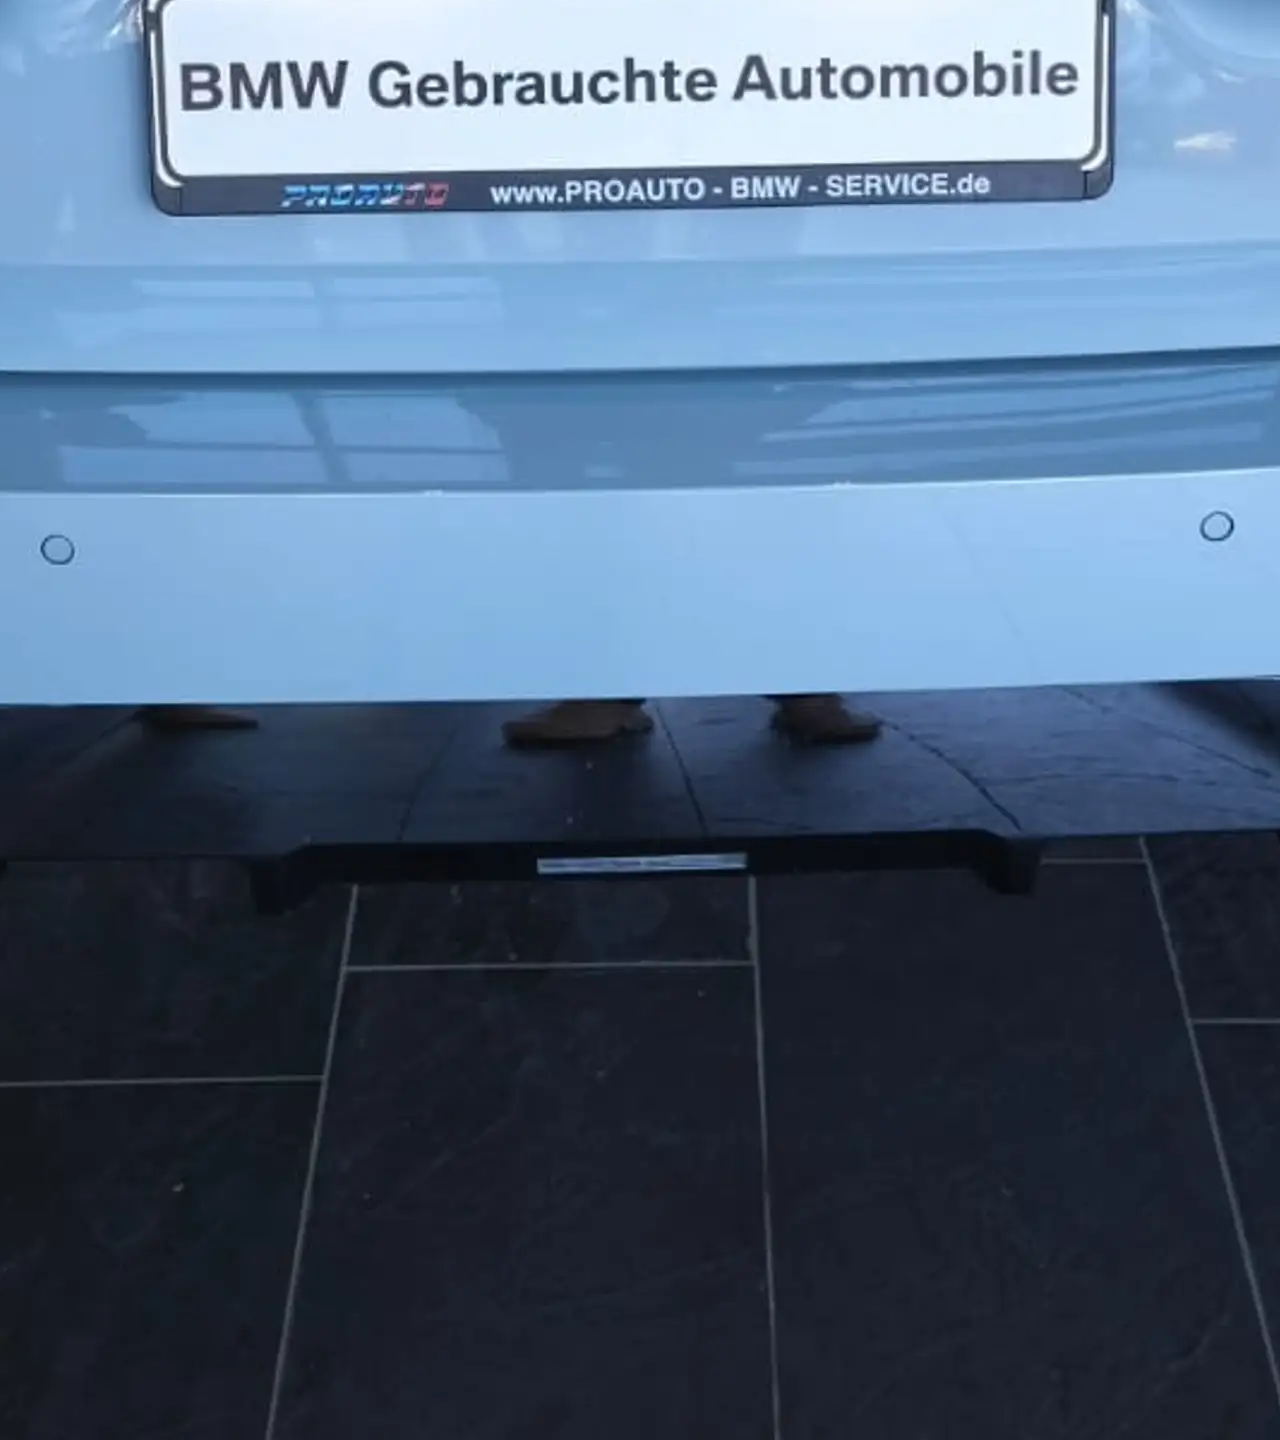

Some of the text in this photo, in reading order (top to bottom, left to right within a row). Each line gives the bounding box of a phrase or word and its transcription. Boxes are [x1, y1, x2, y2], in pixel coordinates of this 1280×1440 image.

[180, 49, 1079, 111] BMW Gebrauchte Automobile
[280, 183, 450, 208] PROAUTO
[489, 178, 705, 204] www.PROAUTO
[730, 175, 802, 199] BMW
[824, 172, 991, 197] SERVICE.de
